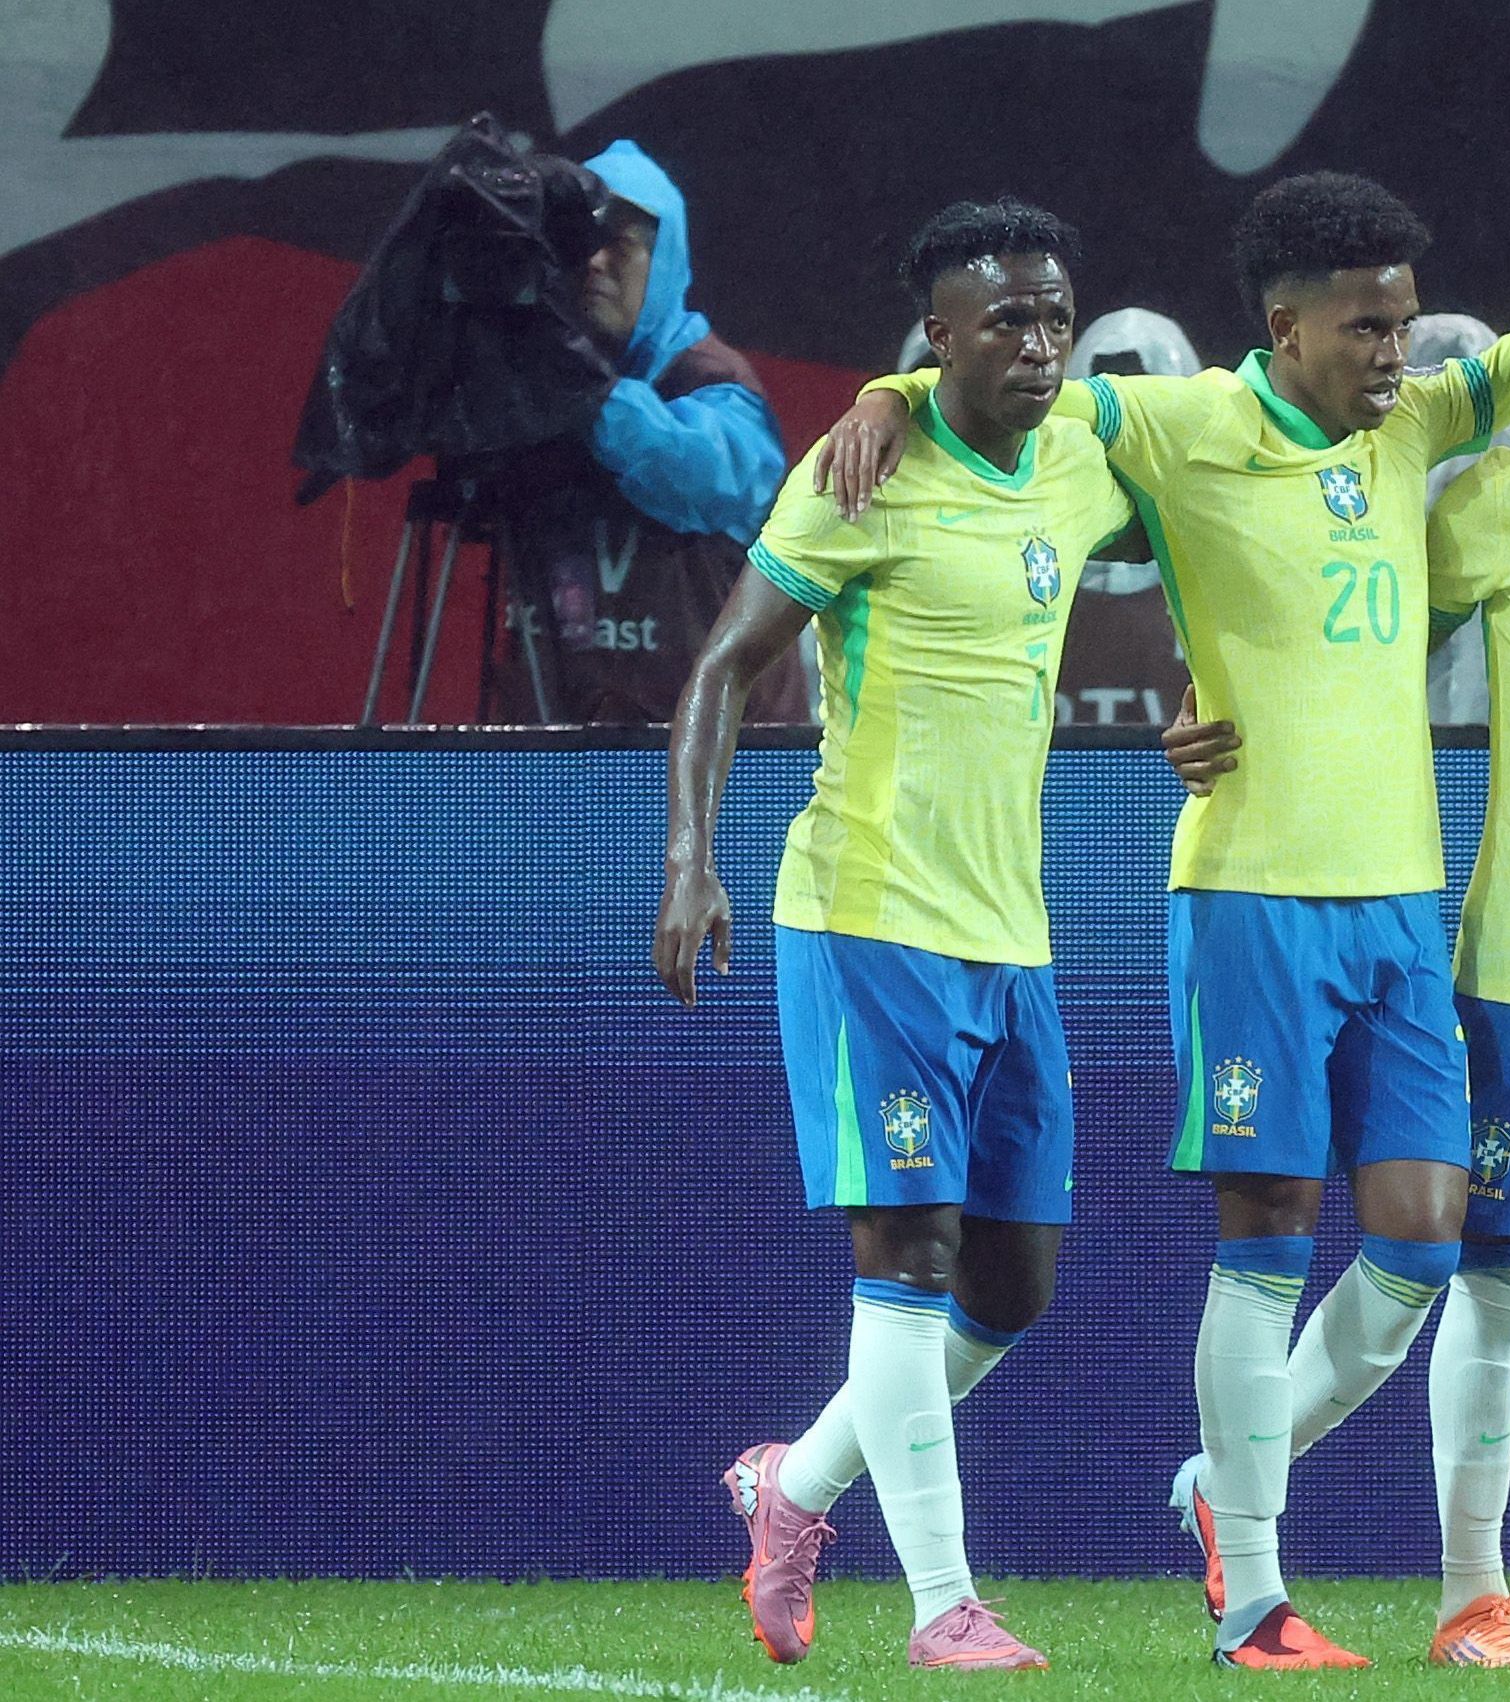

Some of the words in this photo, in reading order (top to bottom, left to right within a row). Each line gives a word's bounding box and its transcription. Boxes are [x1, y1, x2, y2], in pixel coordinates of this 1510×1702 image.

[1333, 485, 1351, 495] CBF
[1329, 528, 1379, 542] BRASIL
[1321, 560, 1400, 645] 20
[1025, 643, 1048, 721] 7
[1212, 1123, 1257, 1137] BRASIL
[890, 1156, 935, 1170] BRASIL
[1468, 1183, 1506, 1200] RASIL
